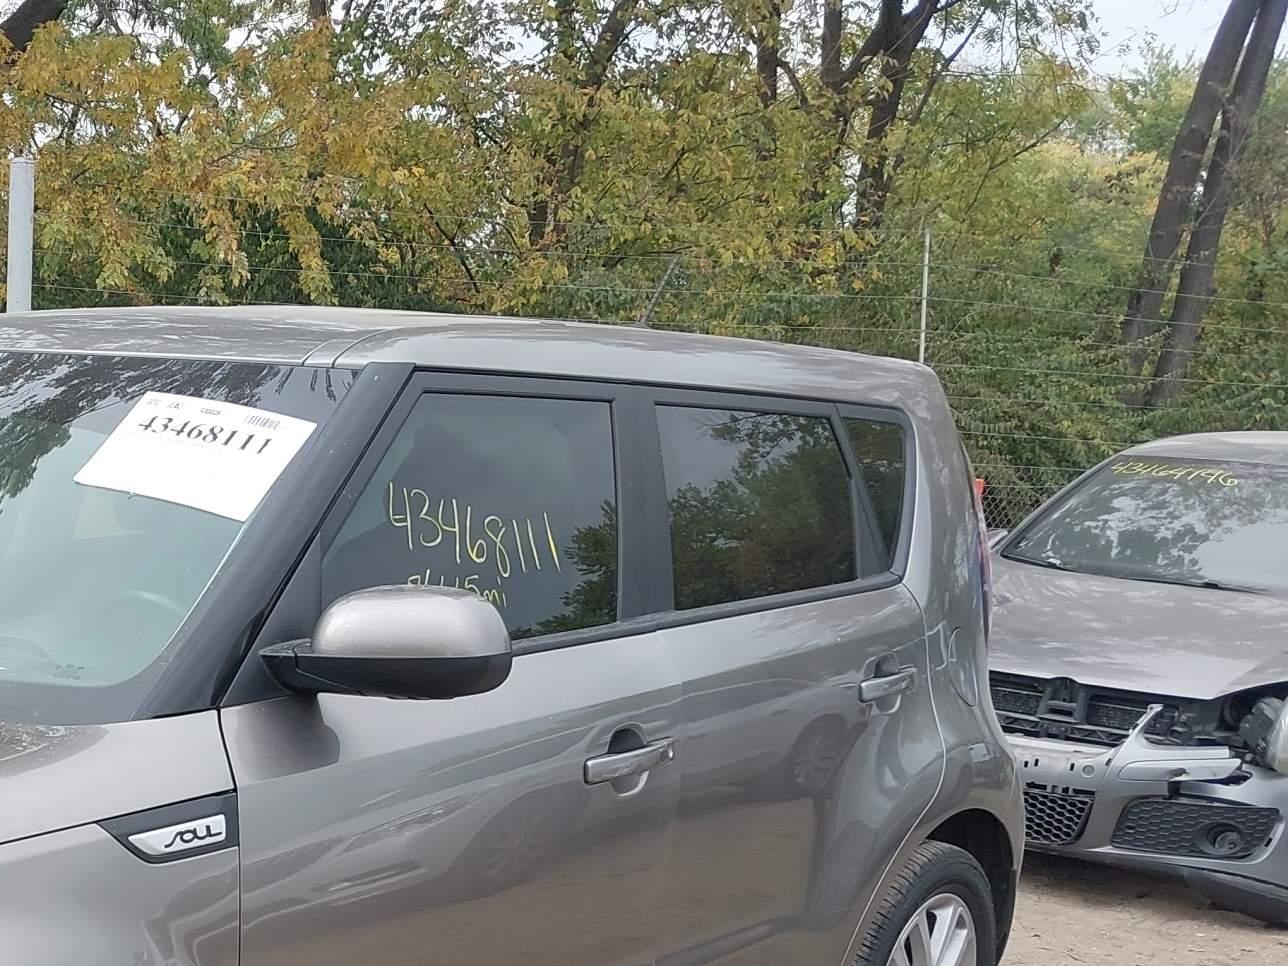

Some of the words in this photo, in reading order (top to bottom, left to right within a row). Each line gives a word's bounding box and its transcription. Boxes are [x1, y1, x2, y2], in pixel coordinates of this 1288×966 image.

[138, 415, 273, 455] 43468111
[388, 480, 562, 578] 43468111
[163, 824, 223, 849] SOUL
